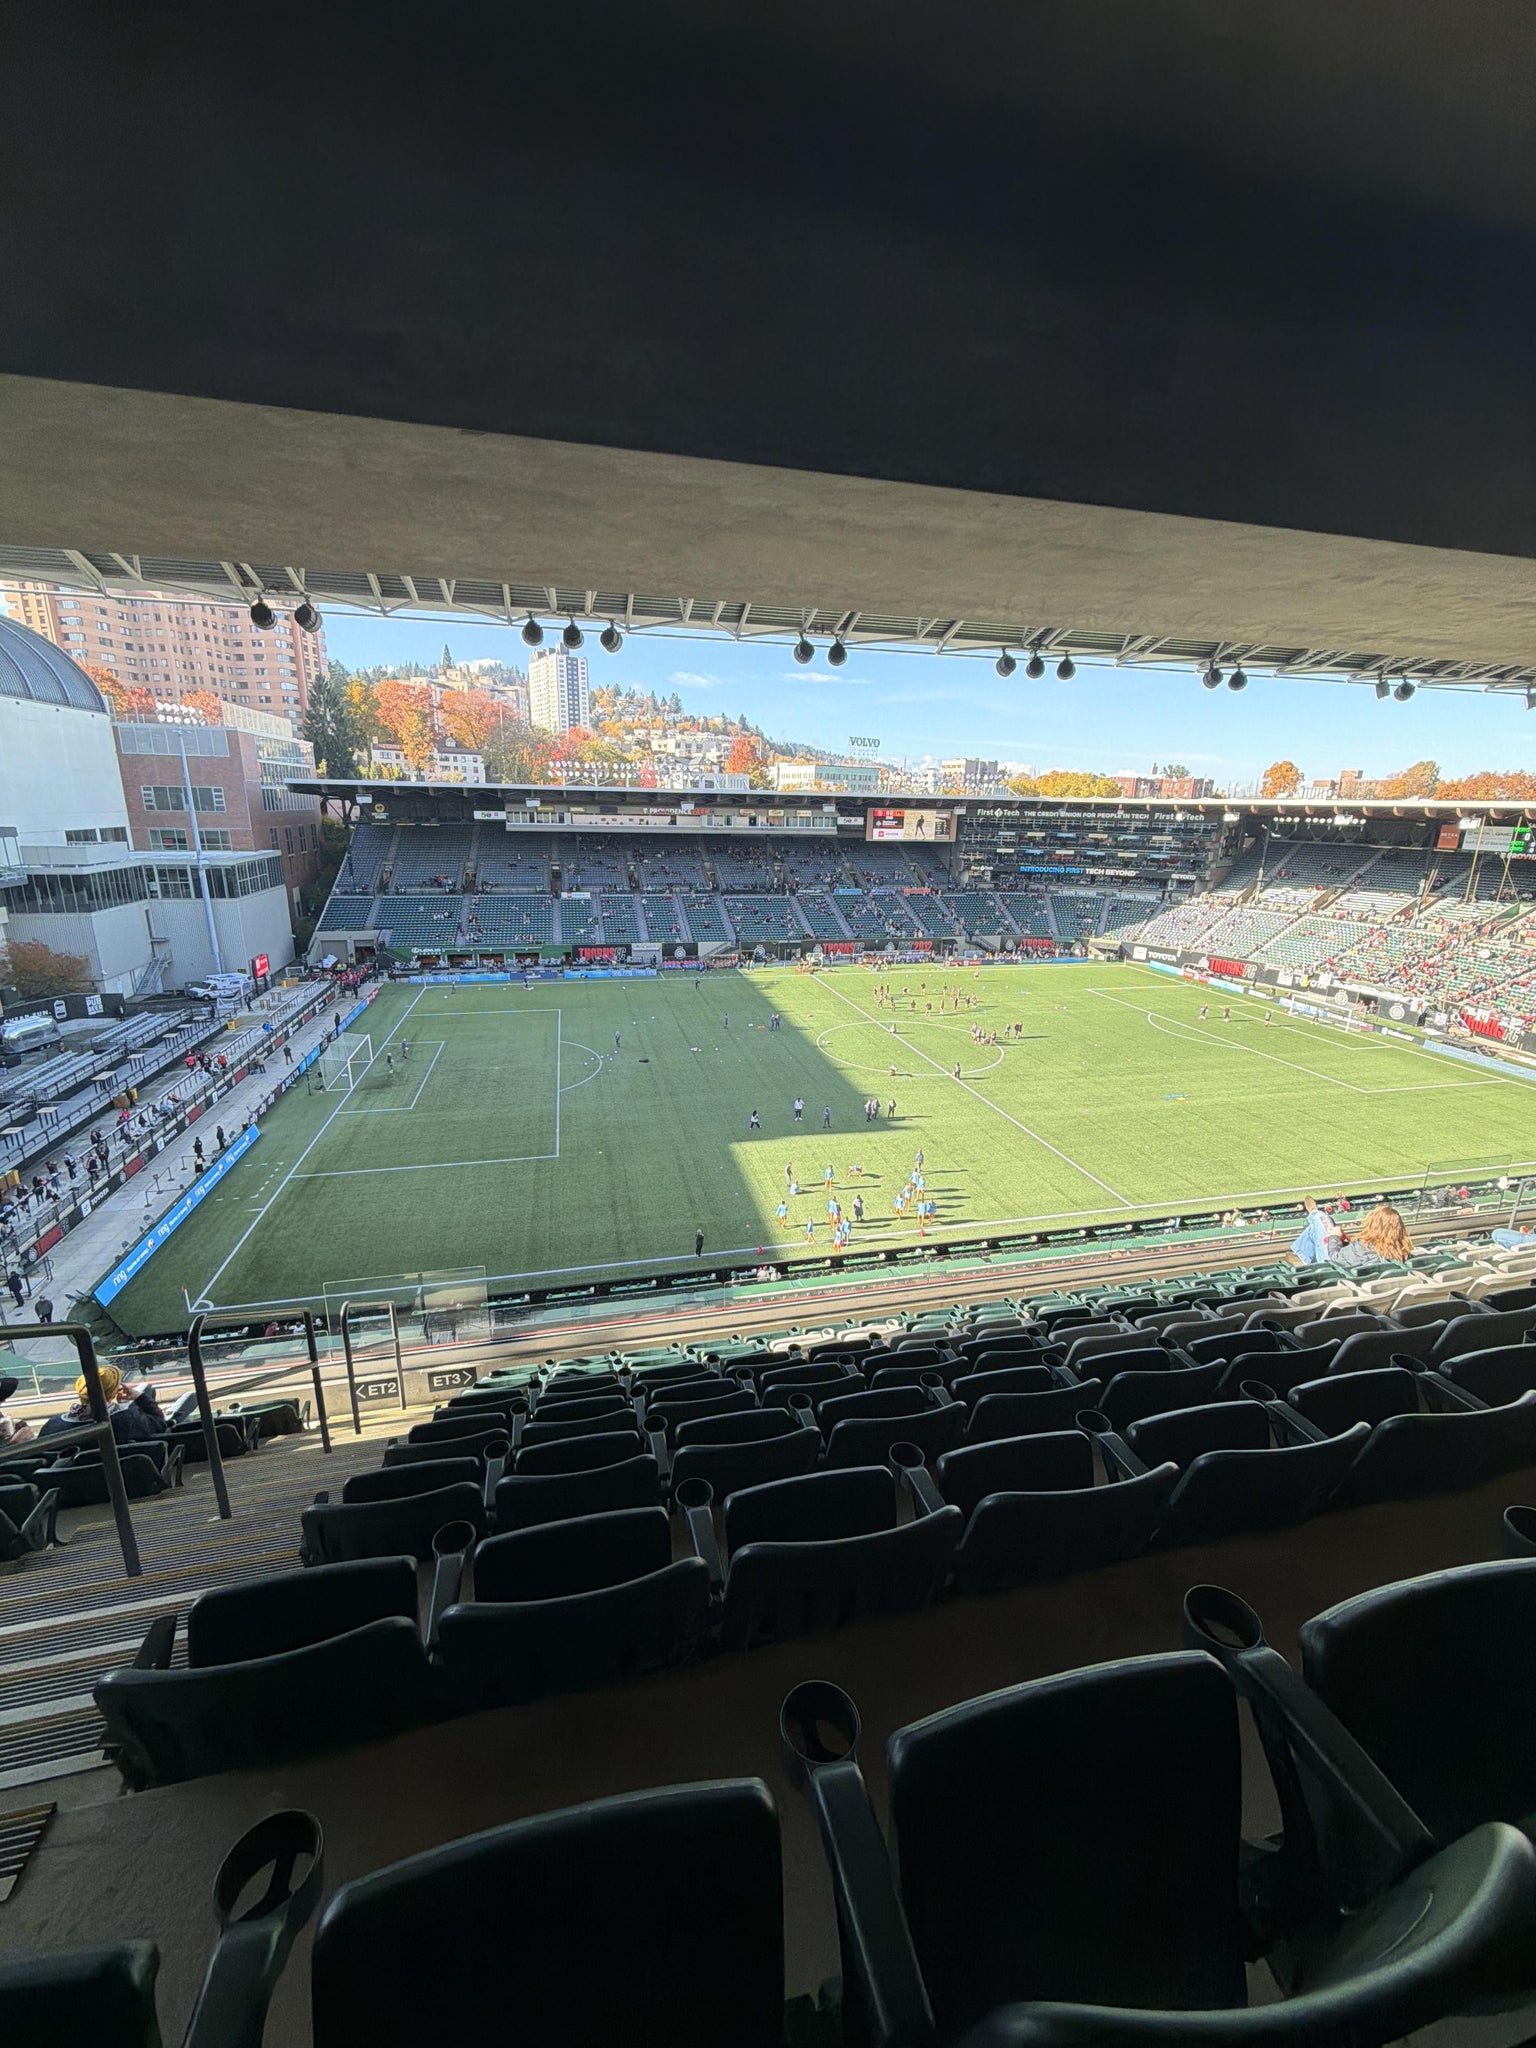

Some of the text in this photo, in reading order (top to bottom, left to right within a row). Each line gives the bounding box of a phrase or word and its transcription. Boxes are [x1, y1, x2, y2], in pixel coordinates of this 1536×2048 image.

[849, 736, 880, 748] VOLVO
[977, 808, 993, 816] First
[1003, 809, 1020, 817] Tech
[1154, 812, 1174, 820] First
[1186, 813, 1205, 821] Tech
[1020, 866, 1065, 874] INTRODUCING
[1066, 867, 1084, 875] FIRST
[1085, 867, 1104, 875] TECH
[578, 947, 615, 961] THORNS
[822, 942, 855, 954] THORNS
[1147, 950, 1177, 962] TOYOTA
[1208, 957, 1258, 979] THORNS FC
[86, 997, 102, 1009] PUB
[285, 1069, 300, 1088] DELTA
[91, 1187, 109, 1205] TOYOTA
[157, 1223, 171, 1237] ring
[113, 1270, 128, 1286] ring
[433, 1373, 461, 1387] ET3
[368, 1382, 397, 1396] ET2
